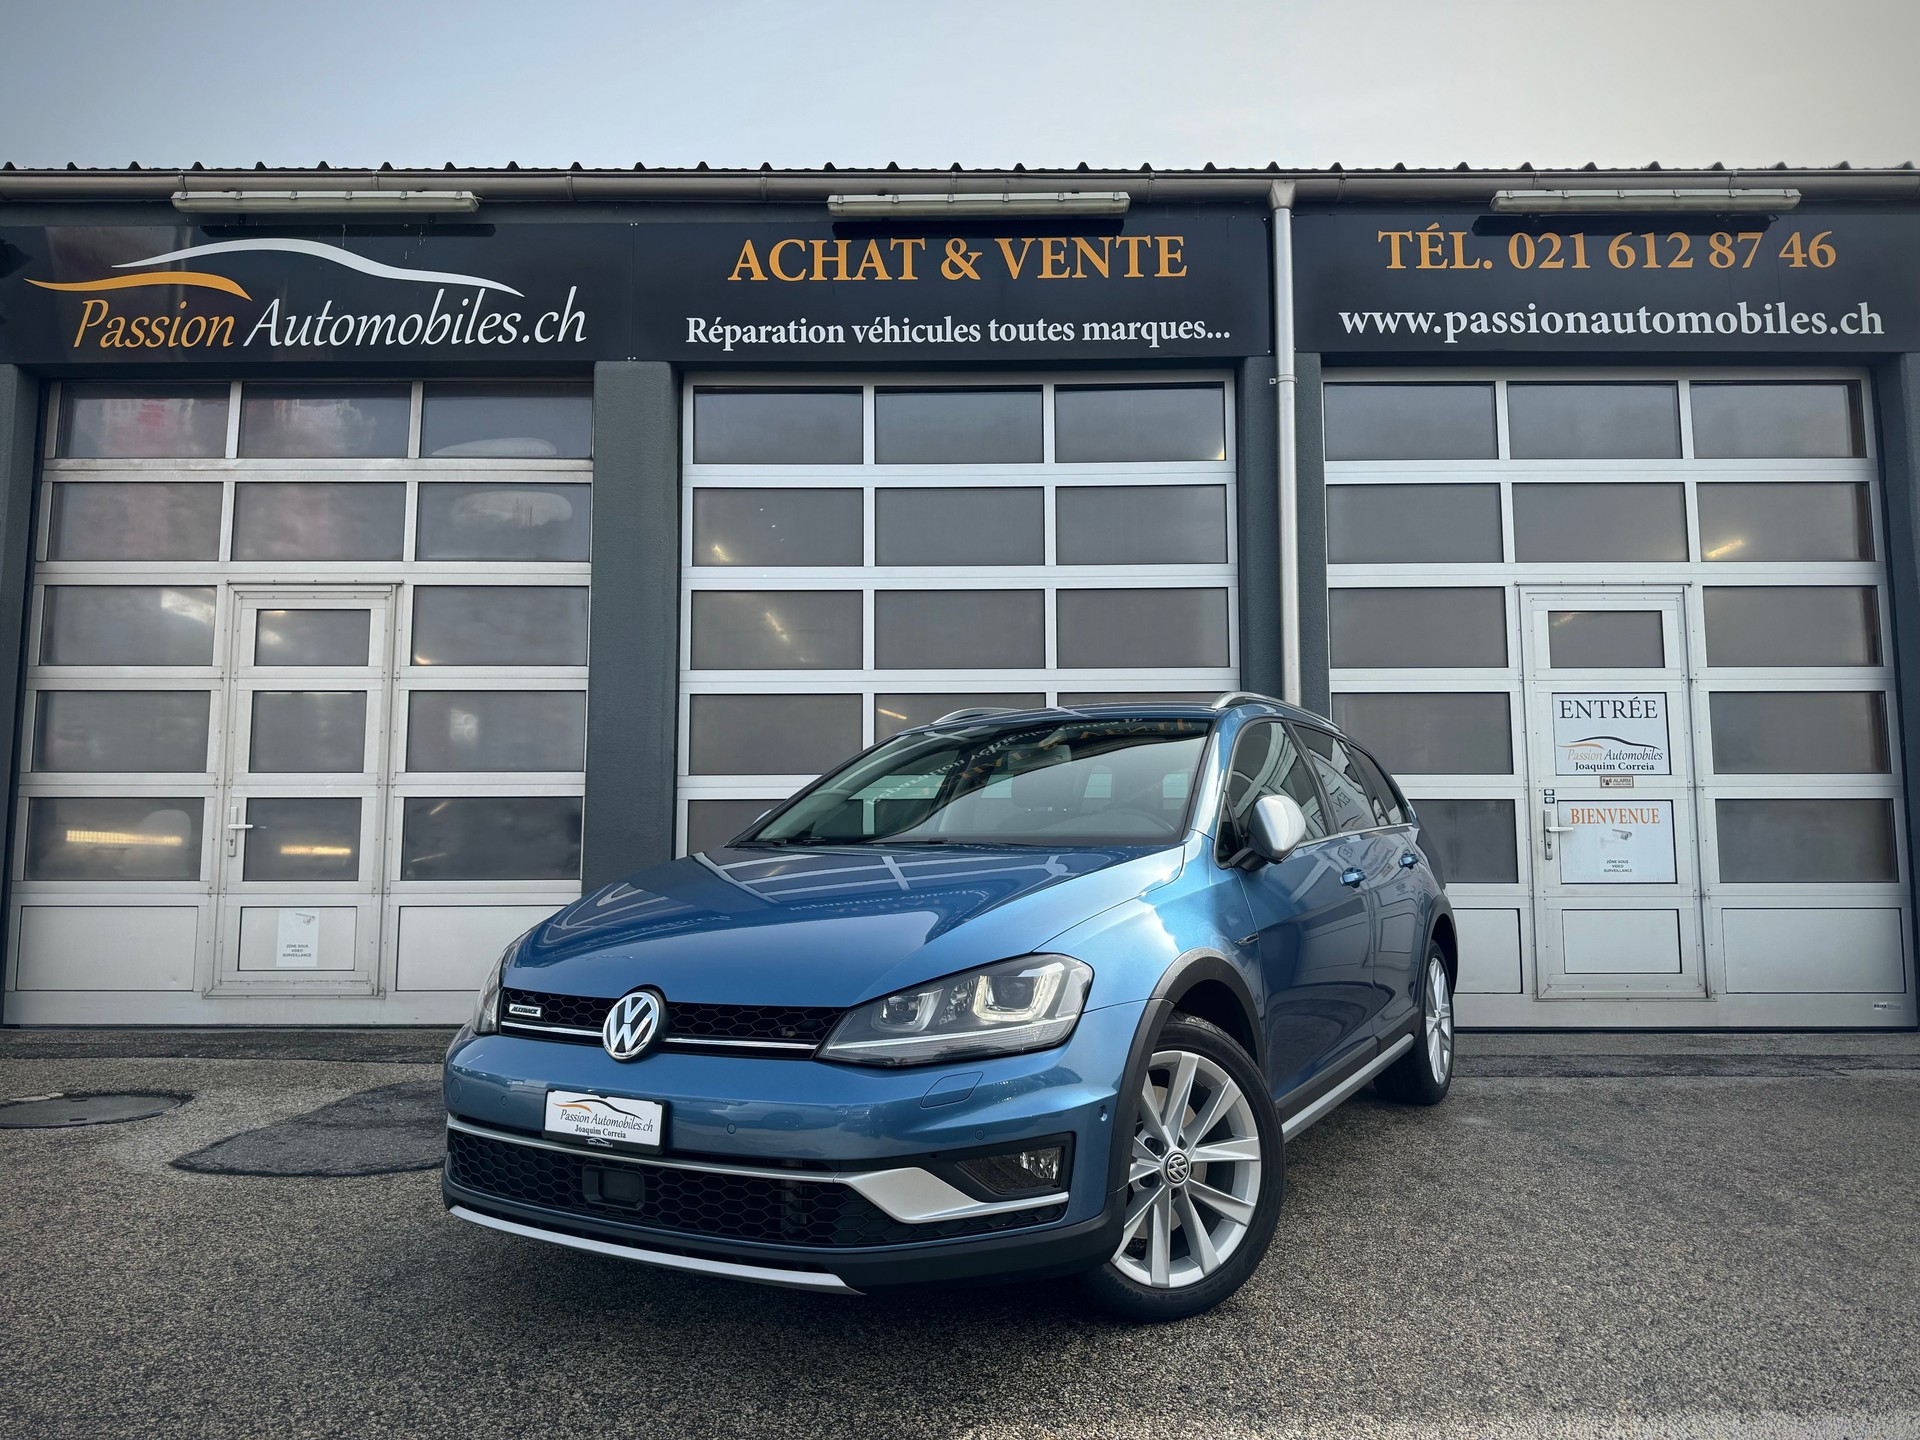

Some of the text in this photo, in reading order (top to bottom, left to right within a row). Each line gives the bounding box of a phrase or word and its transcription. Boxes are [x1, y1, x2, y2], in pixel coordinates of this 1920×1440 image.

[1378, 223, 1836, 269] TÉL. 021 612 87 46
[729, 236, 1188, 281] ACHAT & VENTE
[74, 286, 586, 348] Passion Automobiles.ch
[1338, 302, 1885, 344] www.passionautomobiles.ch
[686, 316, 1231, 352] Réparation véhicules toutes marques...
[1559, 696, 1659, 719] ENTRÉE
[1567, 747, 1663, 761] Passion Automobiles
[1575, 762, 1655, 772] Joaquim Correia
[1570, 808, 1660, 825] BIENVENUE
[560, 1108, 654, 1132] Passion Automobiles.ch
[575, 1125, 627, 1139] Joaquim Correia
